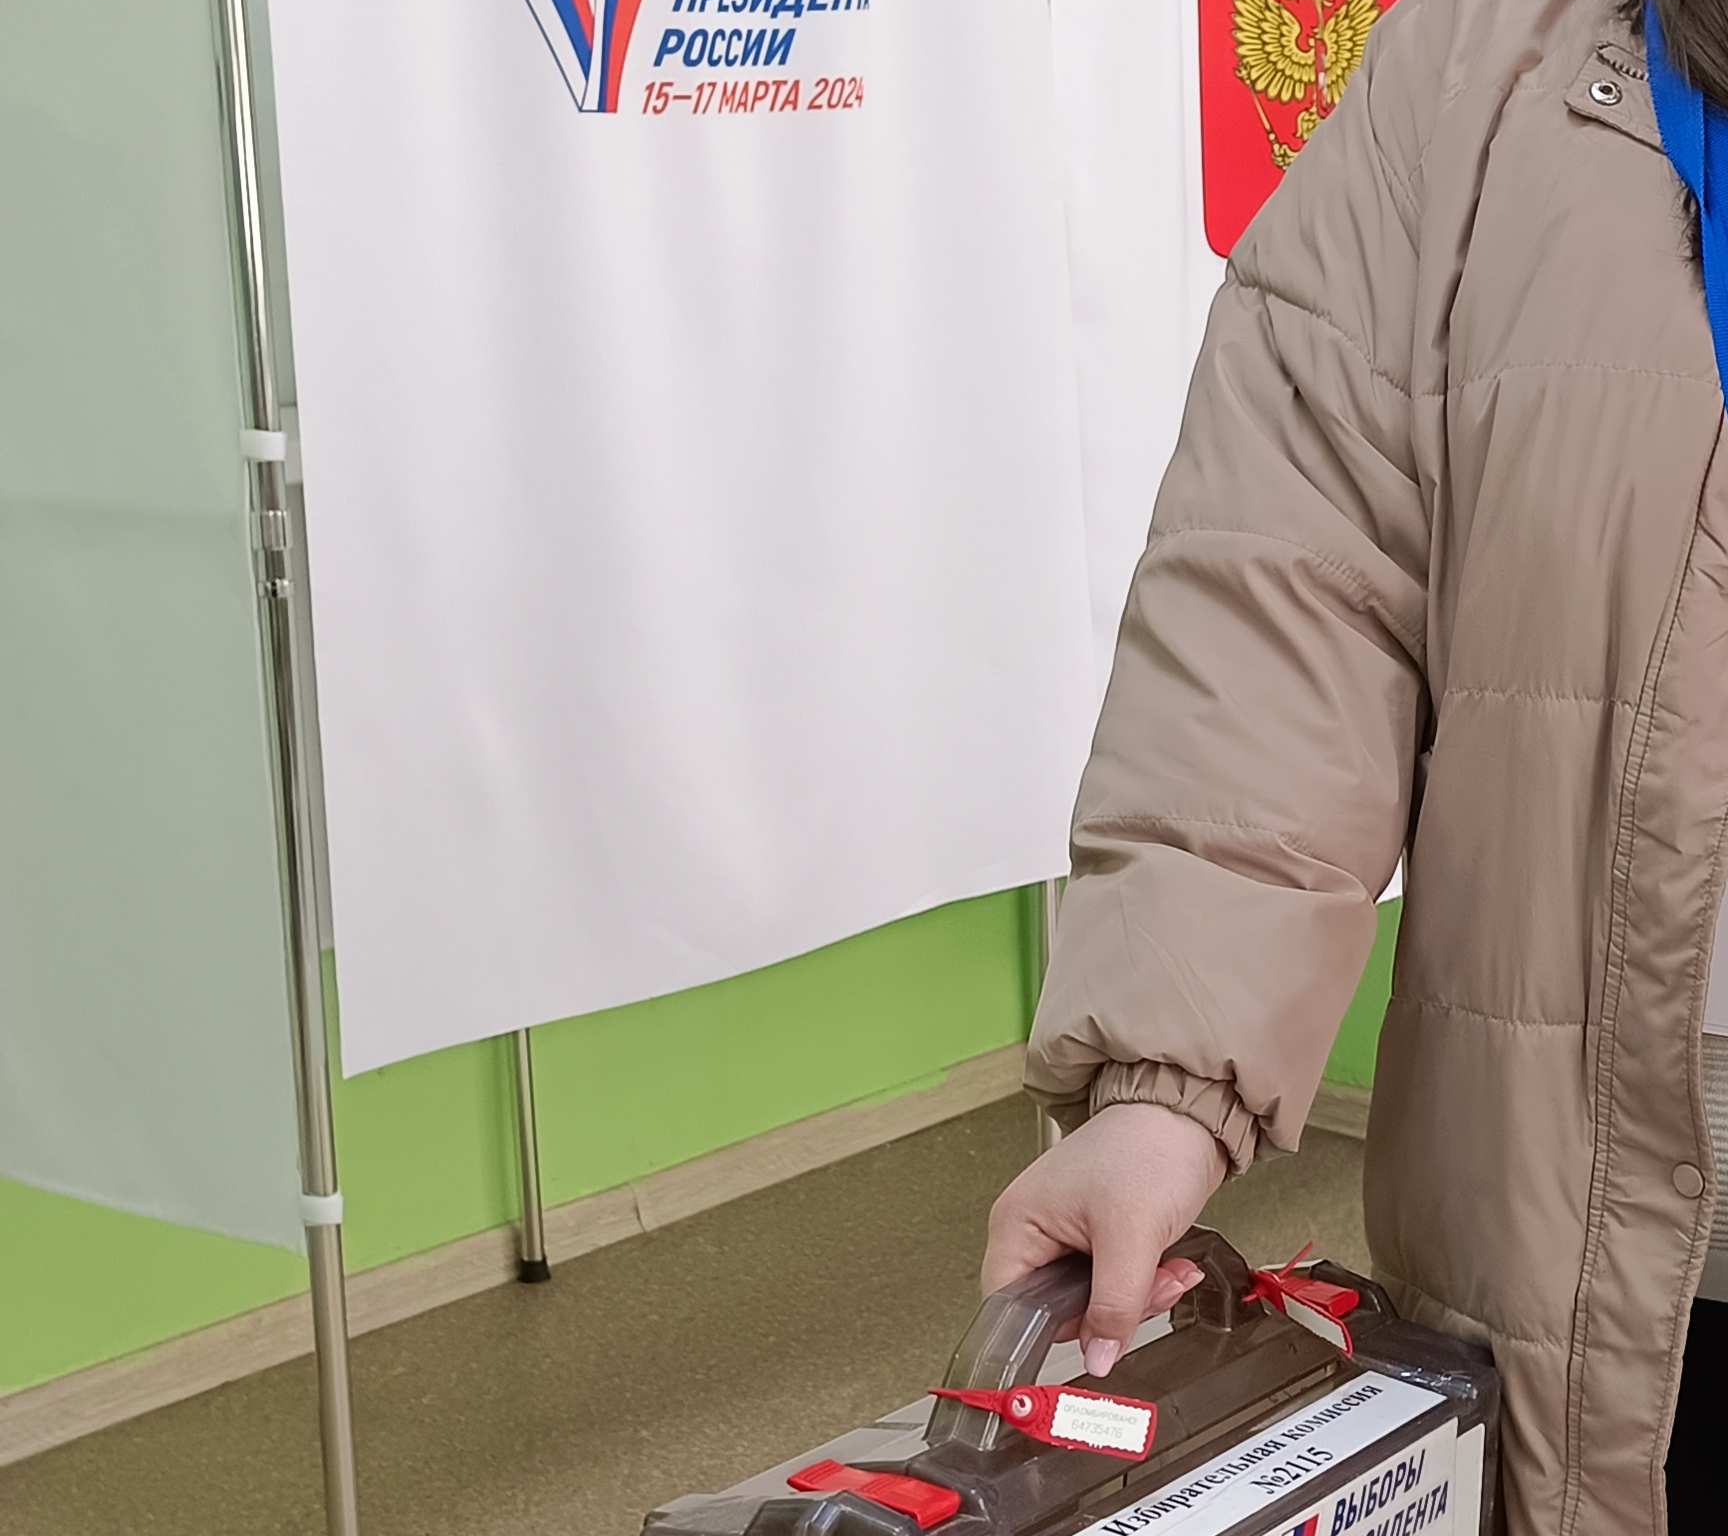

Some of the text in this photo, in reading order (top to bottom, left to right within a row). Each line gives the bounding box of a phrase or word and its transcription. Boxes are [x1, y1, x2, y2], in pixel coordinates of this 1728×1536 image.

[653, 28, 796, 67] РОССИИ
[718, 79, 801, 114] МАРТА
[807, 76, 864, 111] 2024
[1280, 1384, 1383, 1442] комиссия
[1250, 1446, 1335, 1496] №2115
